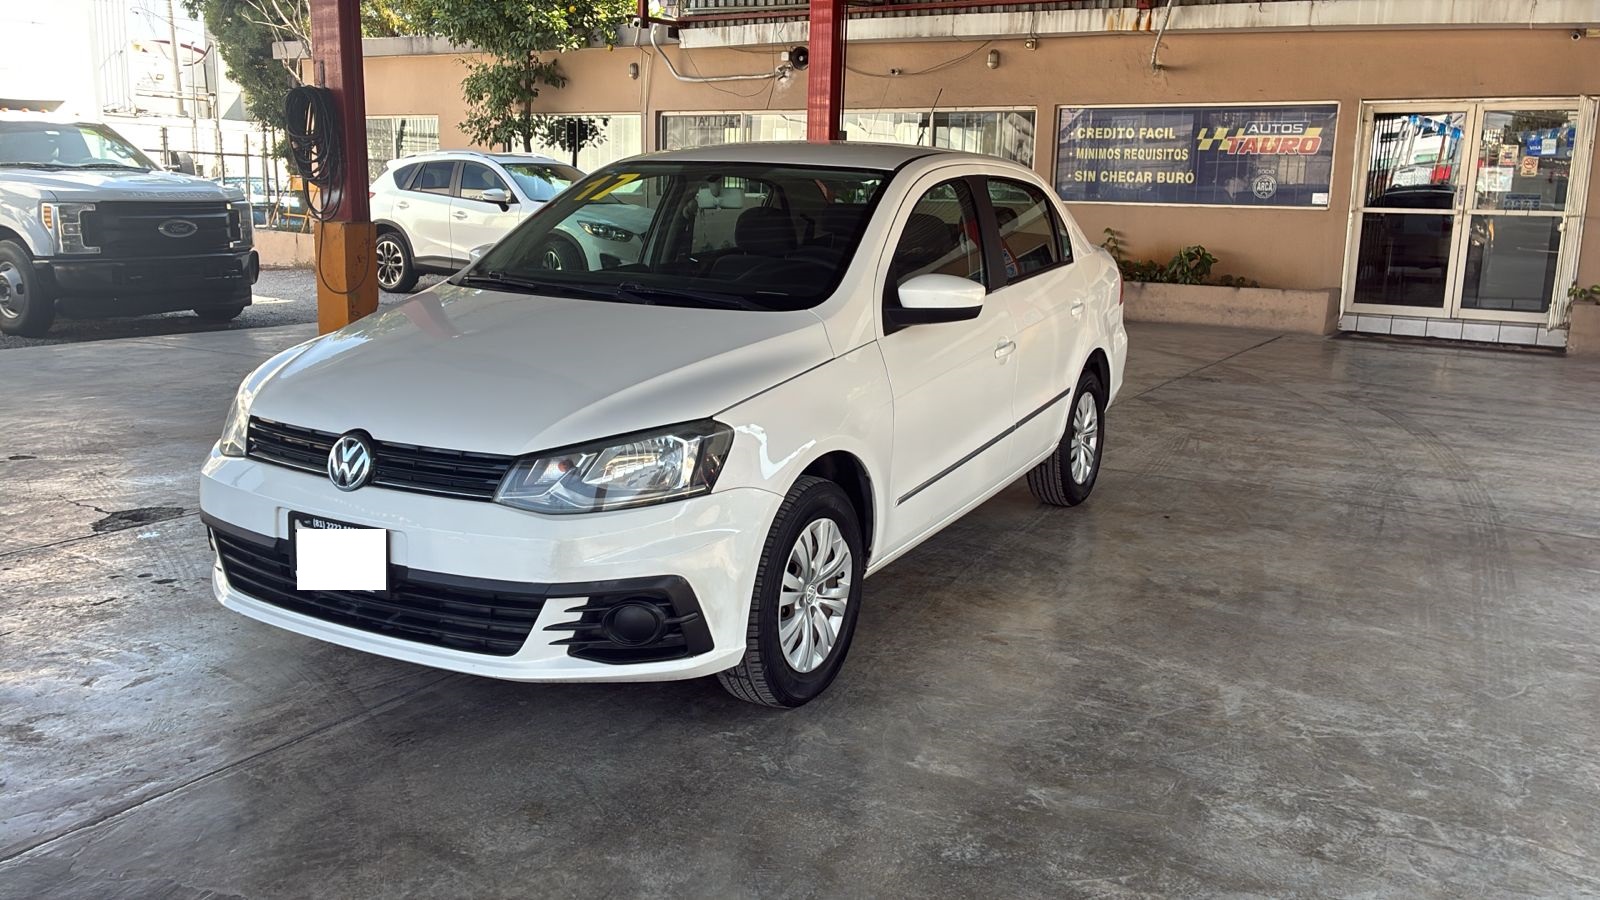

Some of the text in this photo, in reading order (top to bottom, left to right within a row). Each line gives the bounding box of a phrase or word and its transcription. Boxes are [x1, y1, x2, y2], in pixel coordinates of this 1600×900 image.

[1077, 127, 1176, 139] CREDITO FACIL
[1247, 123, 1303, 134] AUTOS
[1226, 136, 1322, 155] TAURO
[1076, 148, 1189, 161] MINIMOS REQUISITOS
[1074, 169, 1195, 183] SIN CHECAR BURÓ
[574, 173, 641, 201] 17
[1256, 181, 1273, 191] ARCA
[313, 518, 325, 529] (81)
